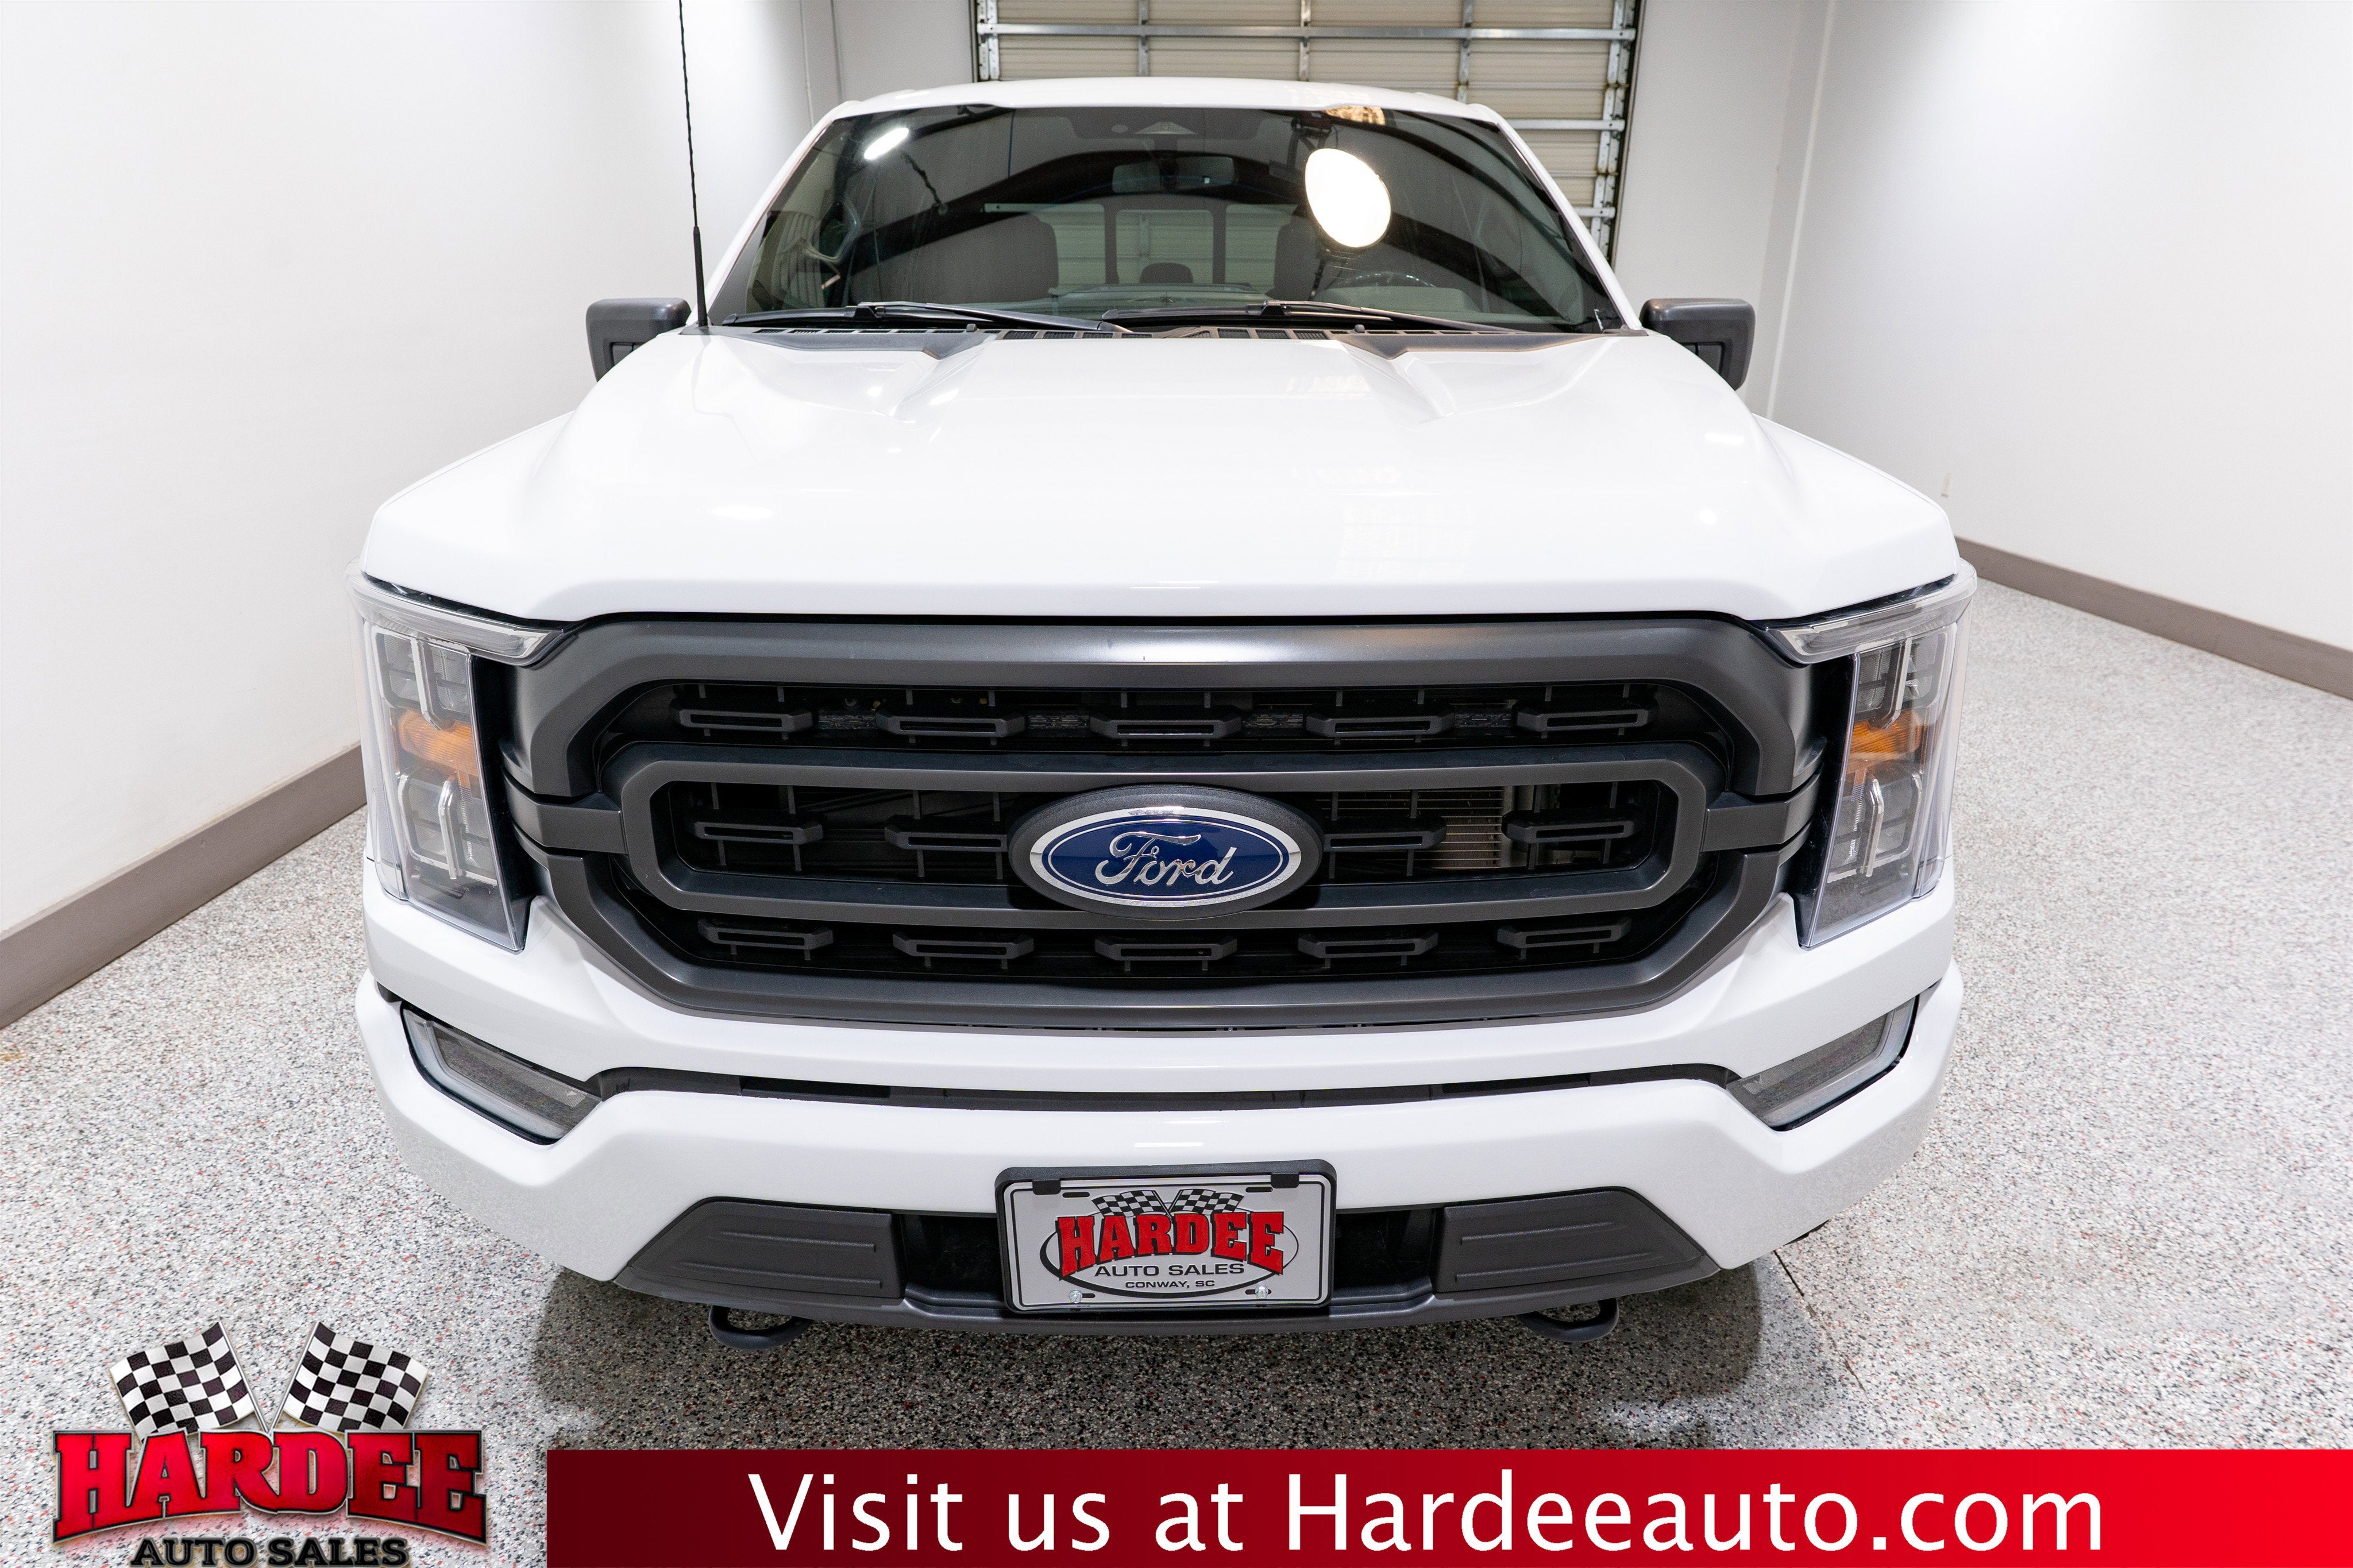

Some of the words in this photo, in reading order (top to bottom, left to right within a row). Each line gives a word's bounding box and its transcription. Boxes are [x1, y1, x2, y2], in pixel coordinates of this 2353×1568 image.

[1094, 831, 1237, 886] Ford
[1055, 1211, 1285, 1281] HARDEE
[1094, 1265, 1160, 1277] AUTO
[1168, 1263, 1245, 1276] SALES
[1125, 1281, 1190, 1289] CONWAY,
